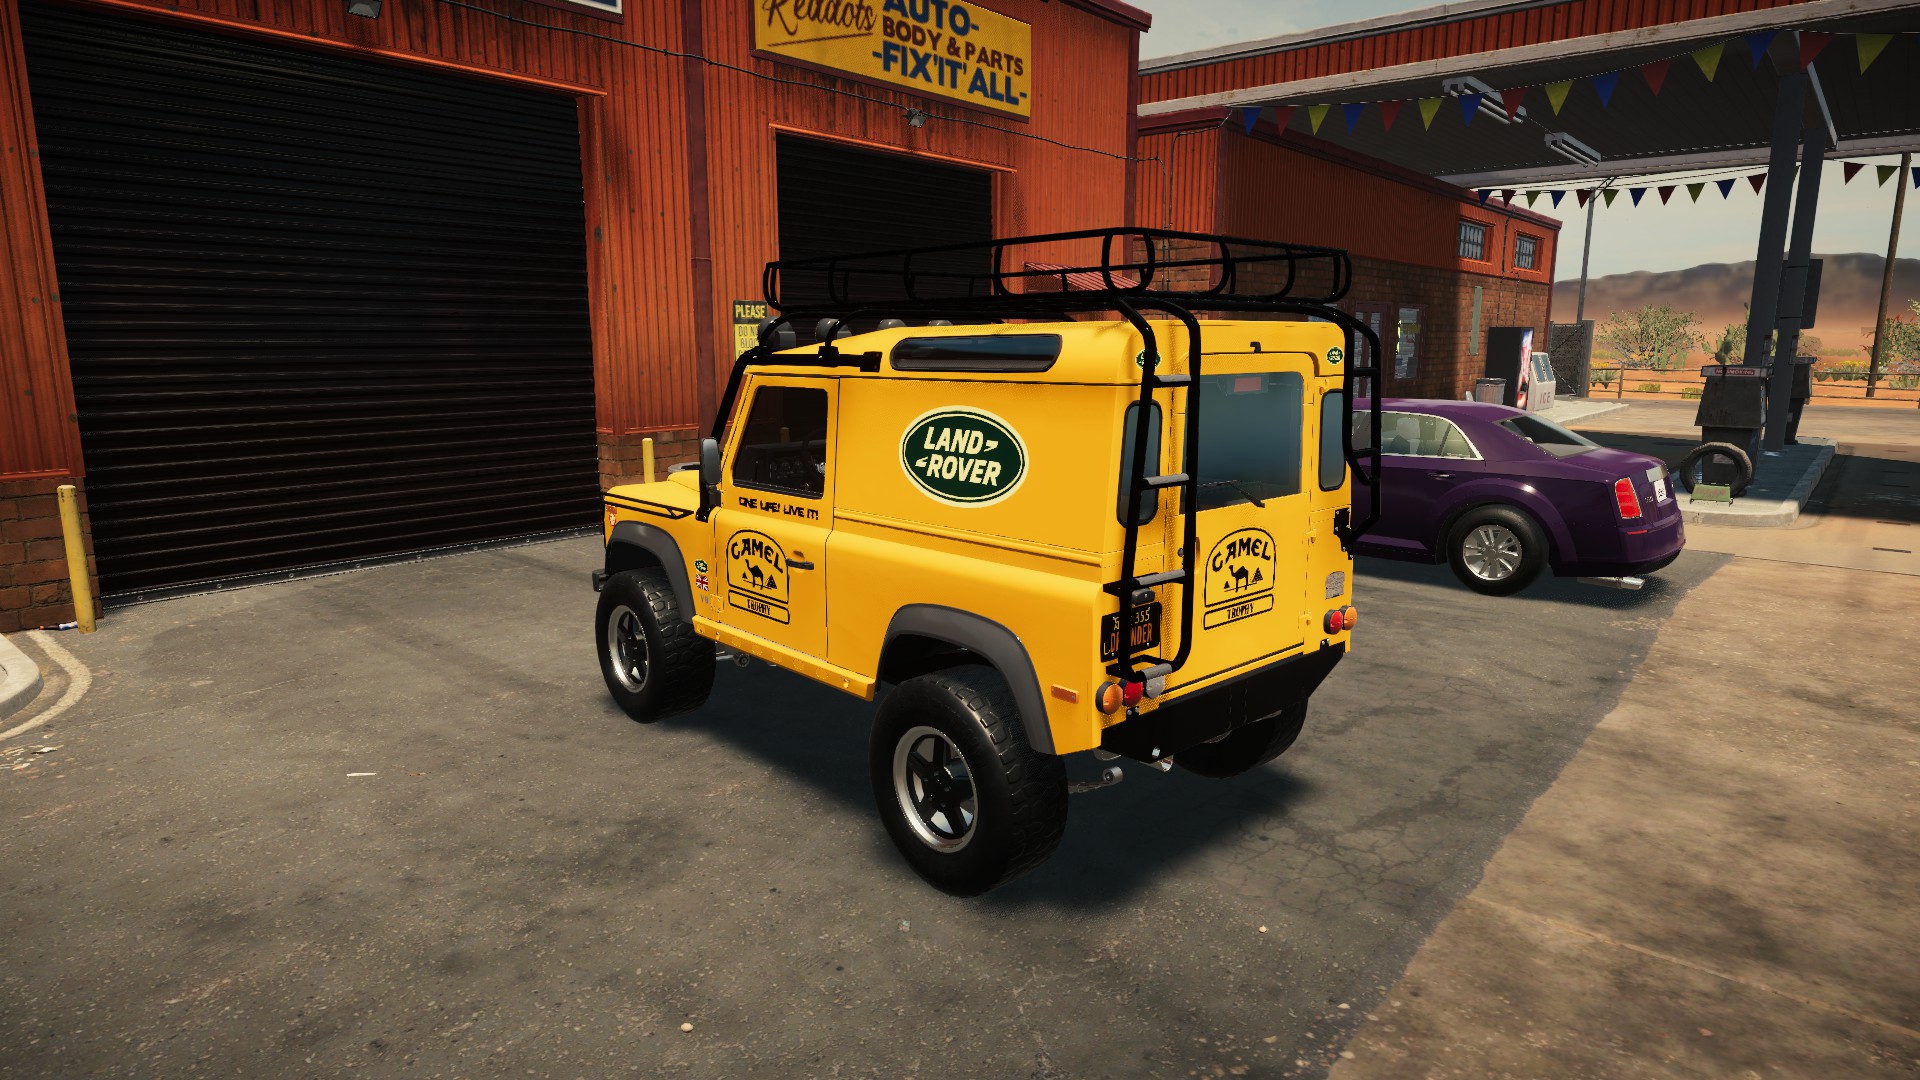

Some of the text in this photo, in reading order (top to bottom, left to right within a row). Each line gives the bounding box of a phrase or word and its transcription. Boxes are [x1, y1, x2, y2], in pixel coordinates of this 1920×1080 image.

[762, 0, 878, 36] Reddots
[883, 16, 1023, 76] BODY & PARTS
[735, 304, 766, 319] PLEASE
[738, 326, 748, 337] DO
[1539, 392, 1551, 404] ICE
[924, 426, 984, 455] LAND
[926, 454, 1002, 487] ROVER
[738, 496, 758, 509] ONE
[783, 504, 805, 518] LIVE
[807, 508, 819, 520] IT!
[731, 538, 784, 574] CAMEL
[1212, 537, 1271, 572] CAMEL
[1226, 602, 1254, 620] TROPHY
